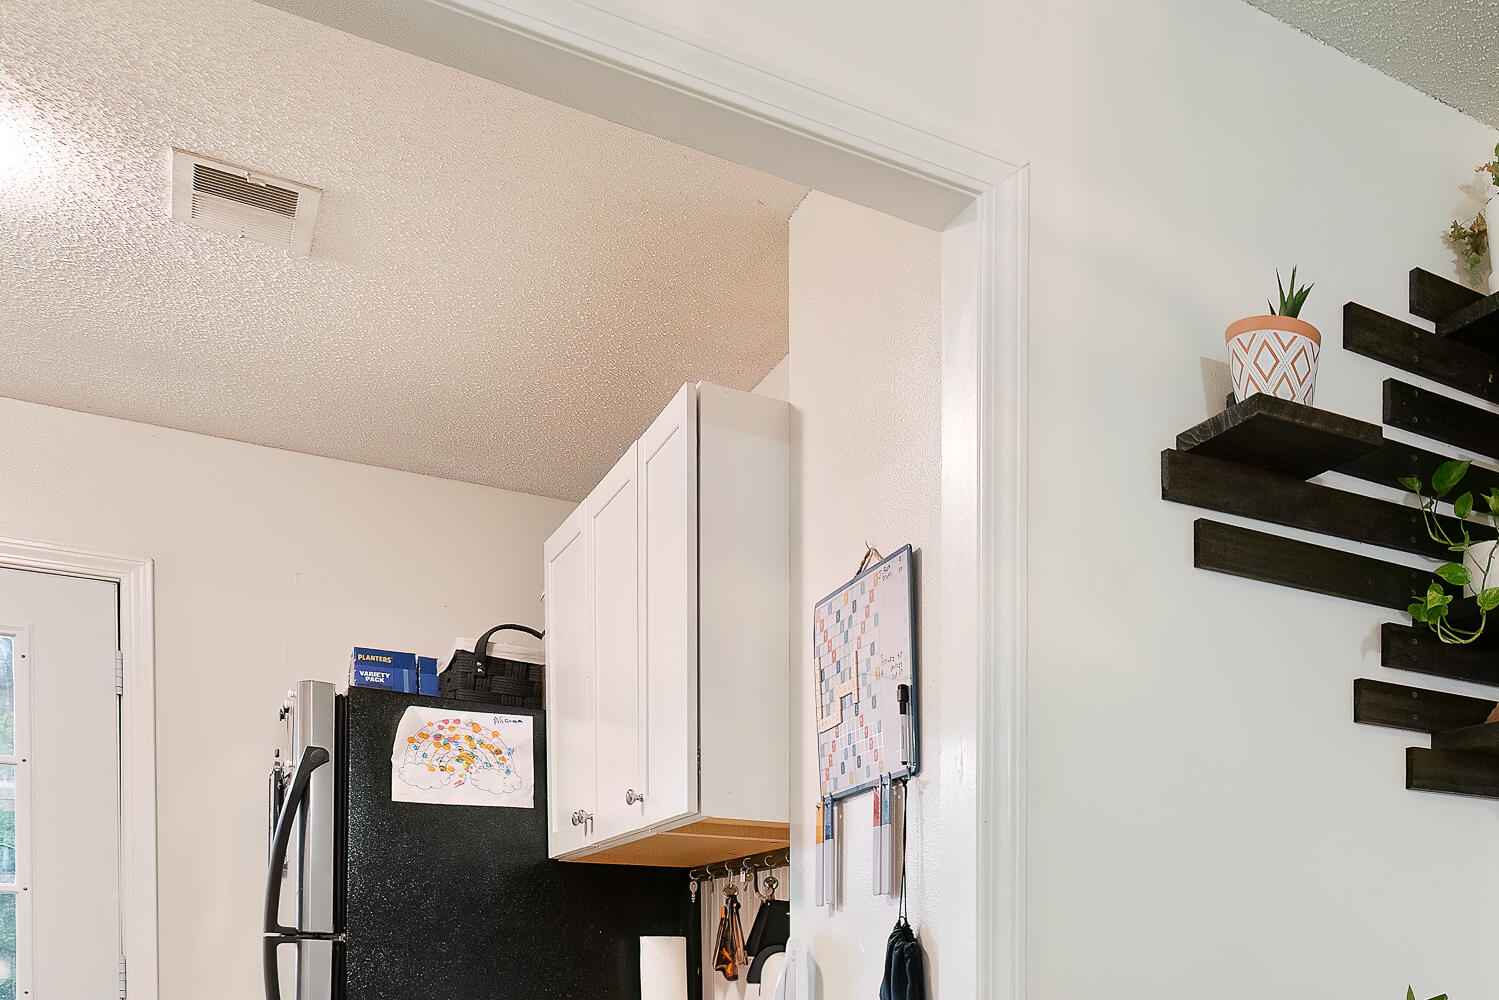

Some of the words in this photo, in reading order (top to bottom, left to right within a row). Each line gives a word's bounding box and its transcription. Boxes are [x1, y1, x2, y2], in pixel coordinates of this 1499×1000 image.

[357, 653, 392, 664] PLANTERS
[359, 670, 391, 679] VARIETY
[365, 676, 385, 684] PACK
